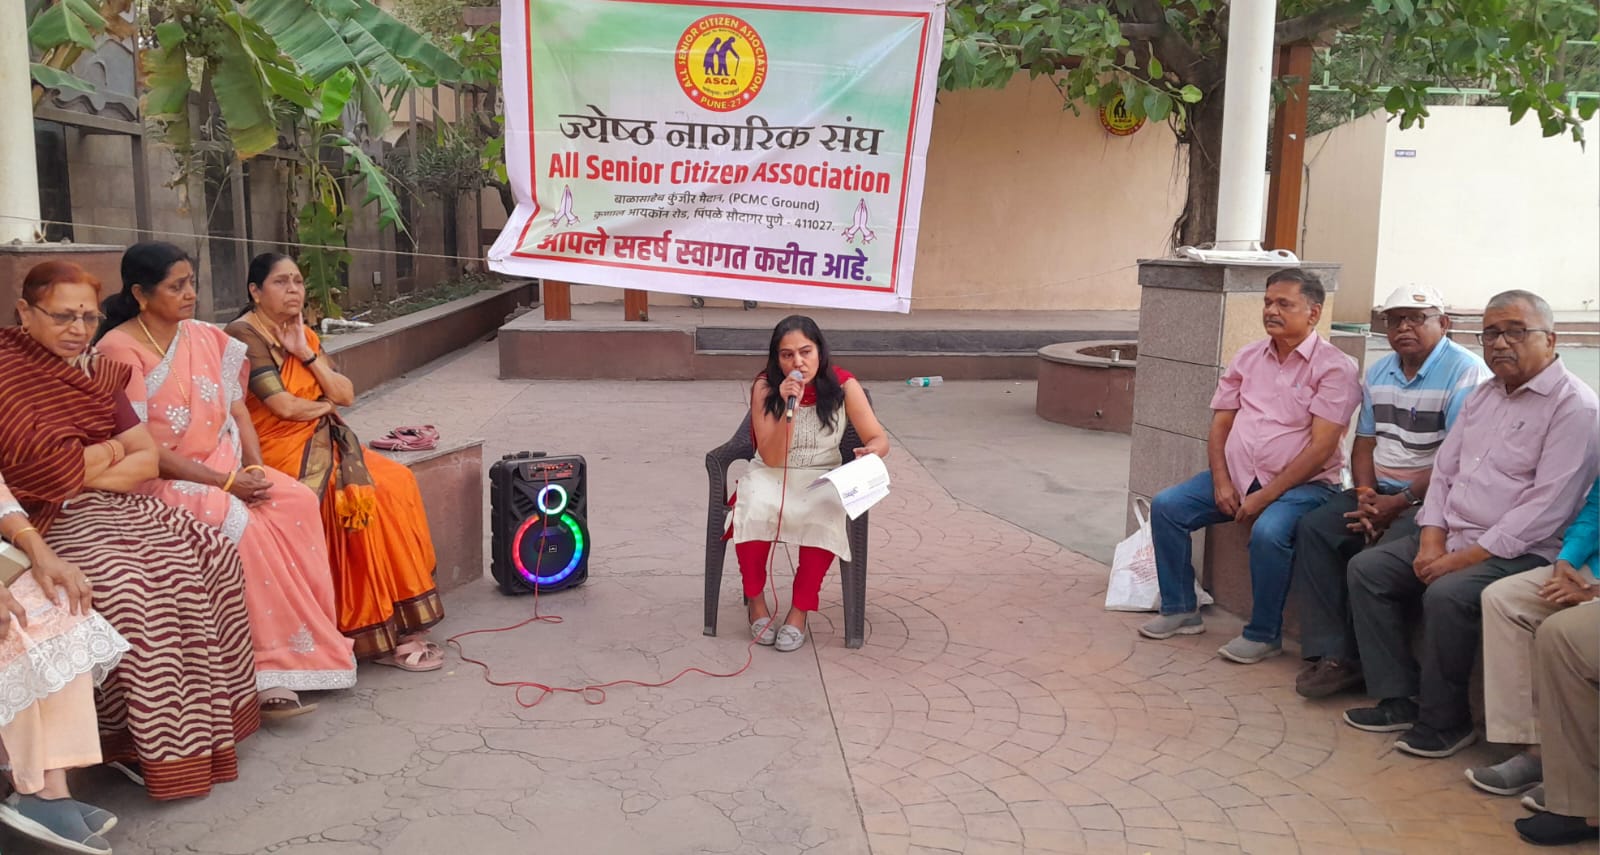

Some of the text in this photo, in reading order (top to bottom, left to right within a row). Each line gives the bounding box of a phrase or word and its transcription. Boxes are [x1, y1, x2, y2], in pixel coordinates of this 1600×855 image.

[678, 17, 766, 93] ALL SENIOR CITIZEN ASSOCIATION
[704, 77, 738, 86] ASCA
[700, 95, 742, 109] PUNE-27
[558, 104, 885, 155] ज्येष्ठ नागरिक संघ
[548, 152, 891, 194] All Senior Citizen Association
[667, 190, 696, 206] कुंजीर
[729, 193, 769, 206] (PCMC
[771, 197, 820, 213] Ground)
[672, 208, 690, 220] रोड,
[766, 213, 784, 230] पुणे
[794, 218, 836, 232] 411027.
[536, 226, 872, 282] आपले सहर्ष स्वागत करीत आहे.
